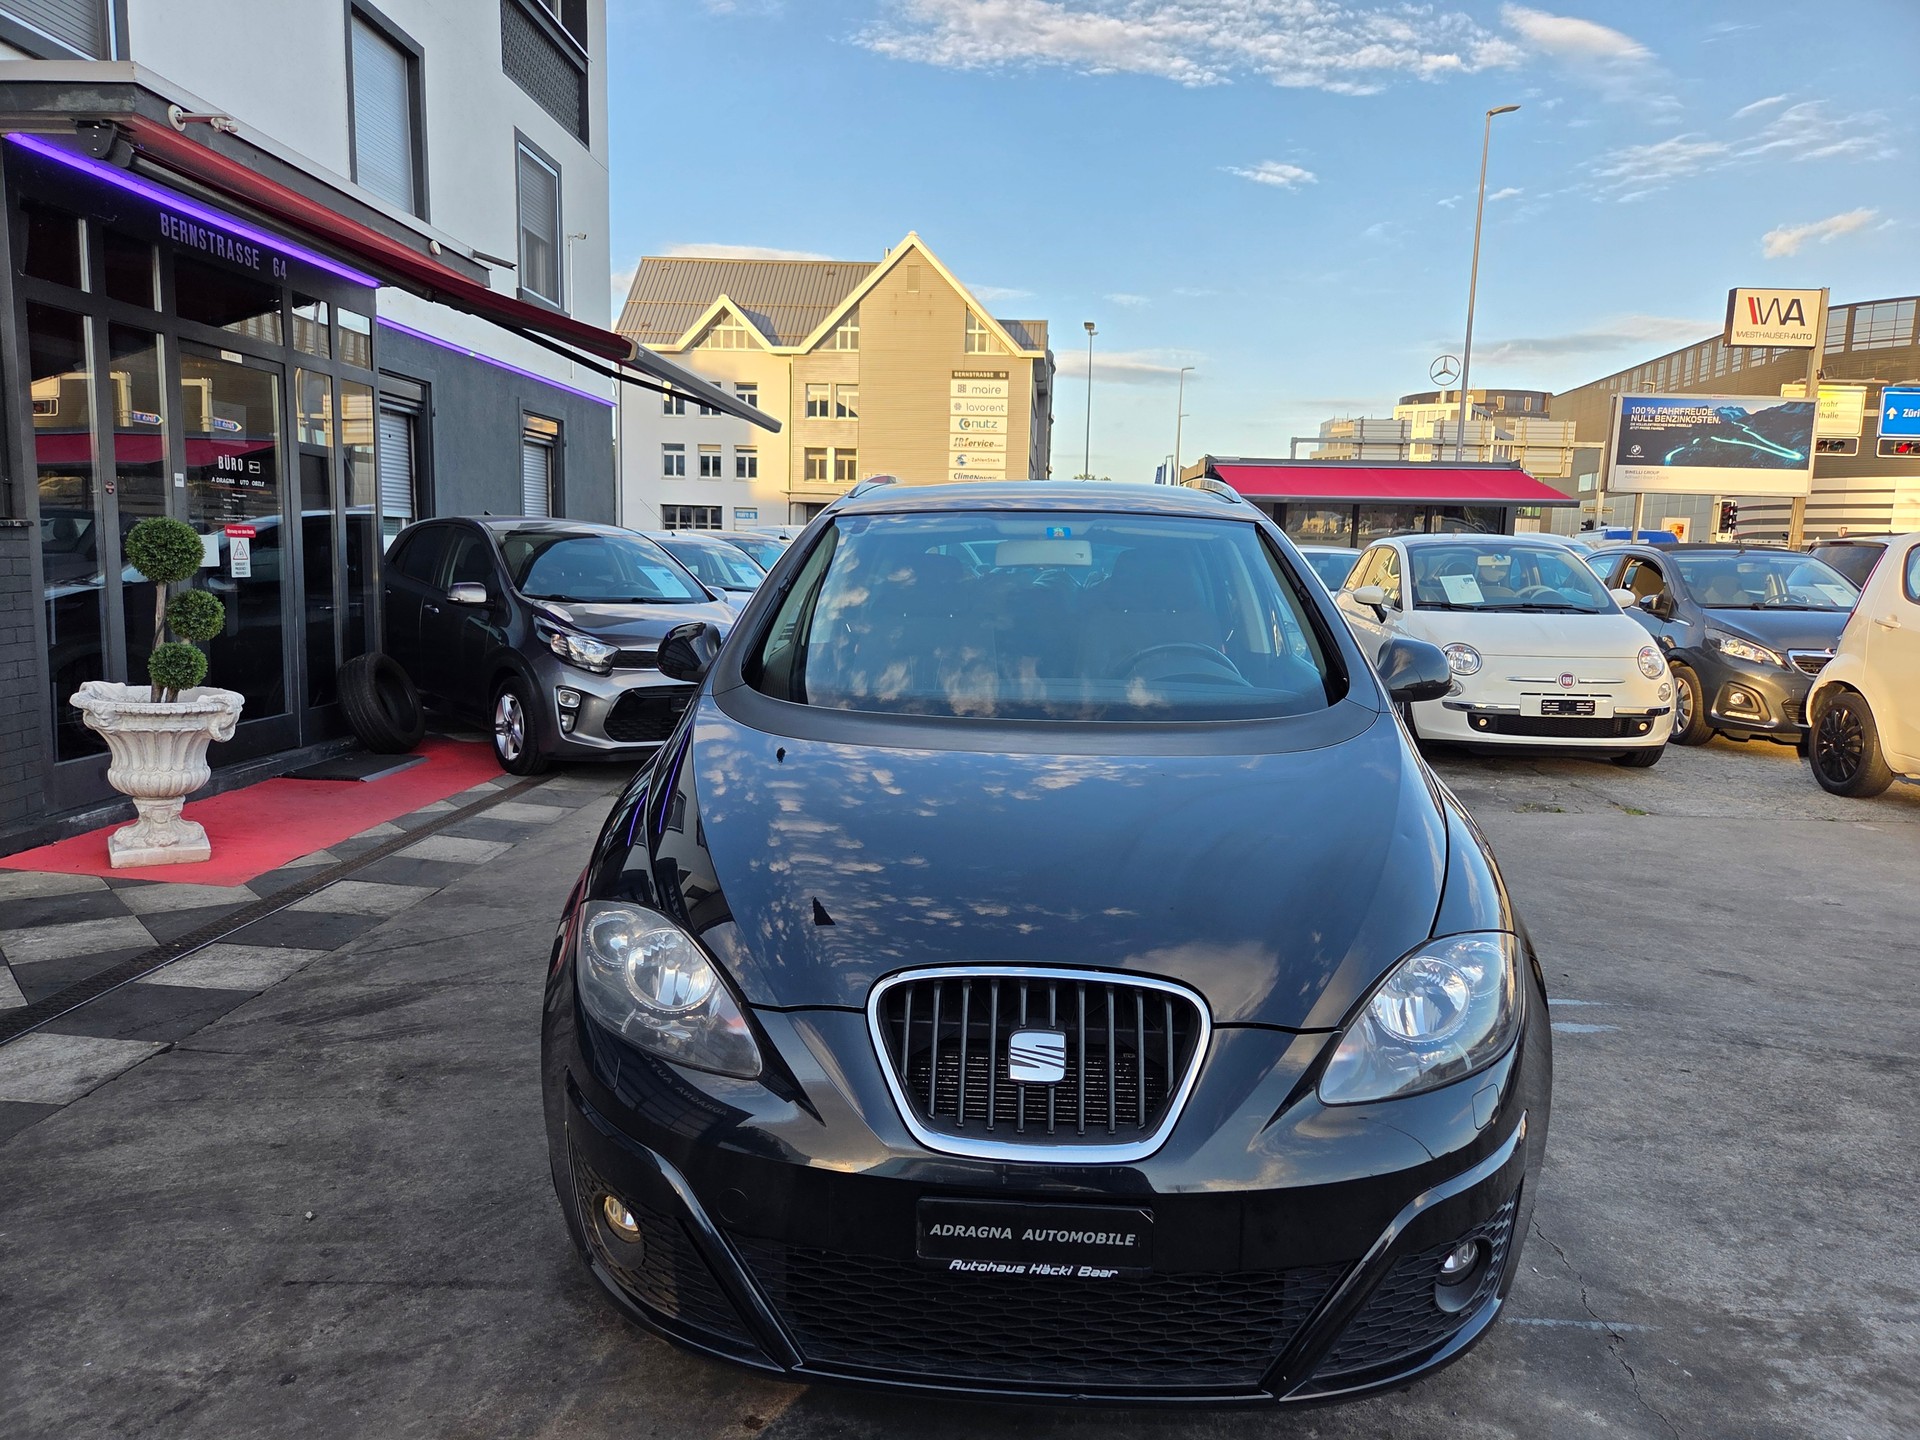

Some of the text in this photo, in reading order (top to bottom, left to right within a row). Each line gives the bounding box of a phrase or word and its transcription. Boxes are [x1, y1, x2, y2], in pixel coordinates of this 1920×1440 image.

[160, 212, 287, 281] BERNSTRASSE 64
[971, 384, 1002, 395] maire
[966, 402, 1005, 412] lavorent
[1657, 407, 1715, 416] FAHRFREUDE.
[971, 419, 998, 429] nutz
[1654, 415, 1721, 424] BENZINKOSTEN.
[218, 454, 243, 471] BÜRO
[929, 1223, 1136, 1246] ADRAGNA AUTOMOBILE
[949, 1259, 1118, 1279] Autohaus Häcki Baar
